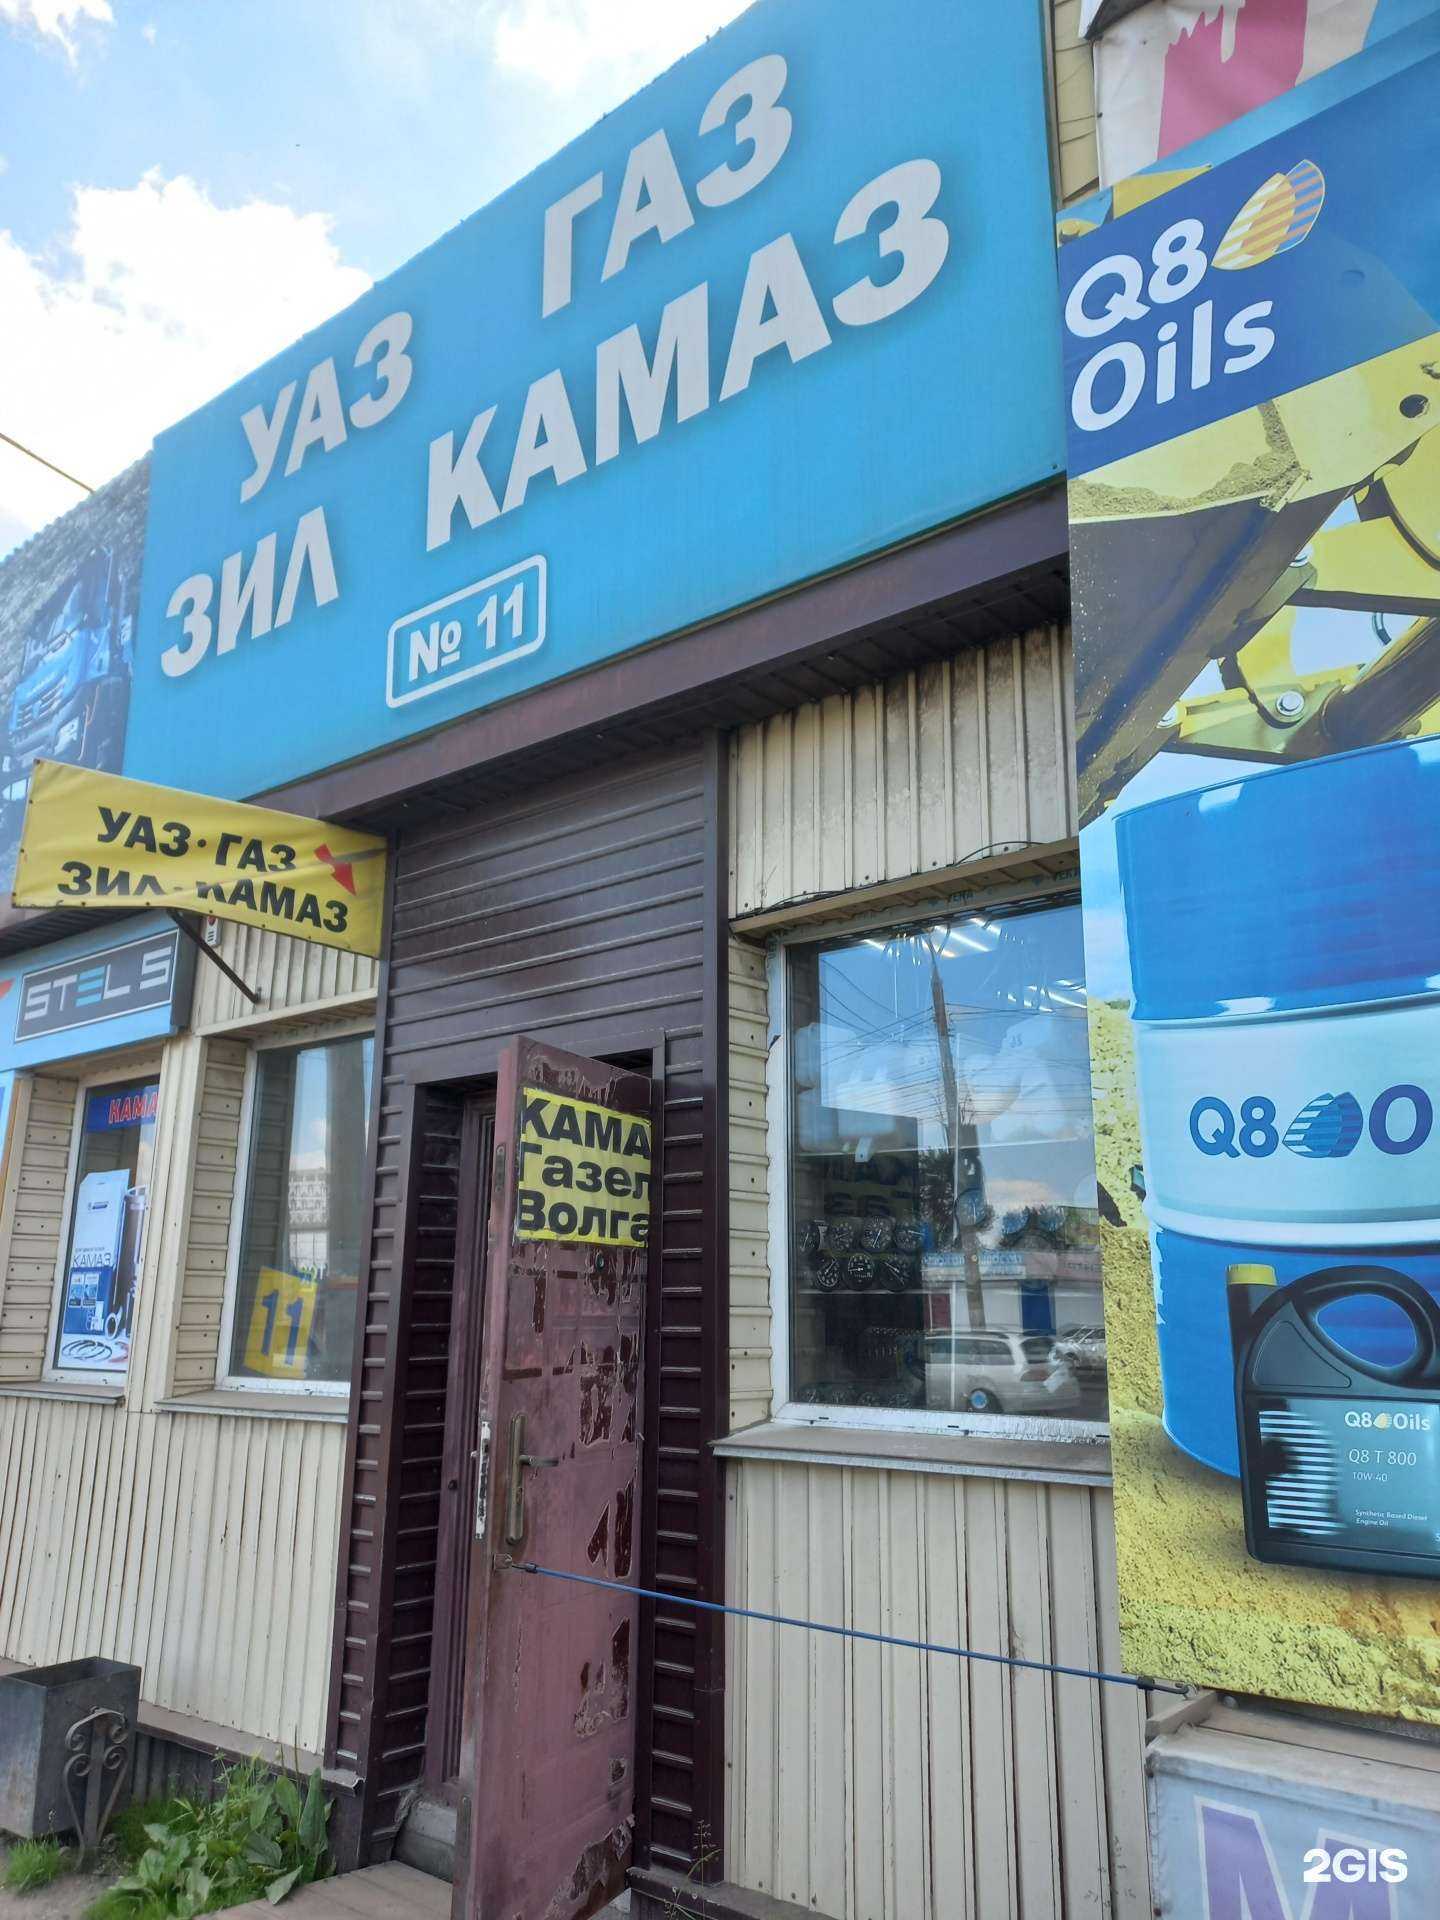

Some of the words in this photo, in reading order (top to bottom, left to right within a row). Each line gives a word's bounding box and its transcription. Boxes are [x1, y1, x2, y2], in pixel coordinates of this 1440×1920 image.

[240, 310, 414, 504] УАЗ
[542, 53, 793, 319] ГАЗ
[1064, 218, 1209, 340] Q8
[1070, 300, 1276, 432] Oils
[160, 506, 339, 678] ЗИЛ
[426, 158, 949, 552] КАМАЗ
[408, 620, 462, 682] №
[477, 582, 524, 650] 11
[97, 806, 192, 858] УАЗ
[215, 832, 297, 873] ГАЗ
[57, 860, 166, 896] ЗИЛ
[24, 946, 172, 1021] STELS
[1189, 1095, 1280, 1159] Q8
[1368, 1084, 1434, 1156] O
[517, 1188, 649, 1242] Волга
[262, 1288, 305, 1367] 11
[1344, 1411, 1373, 1428] Q8
[1393, 1413, 1432, 1431] Oils
[1348, 1448, 1370, 1464] Q8
[1374, 1450, 1384, 1463] T
[1387, 1451, 1417, 1466] 800
